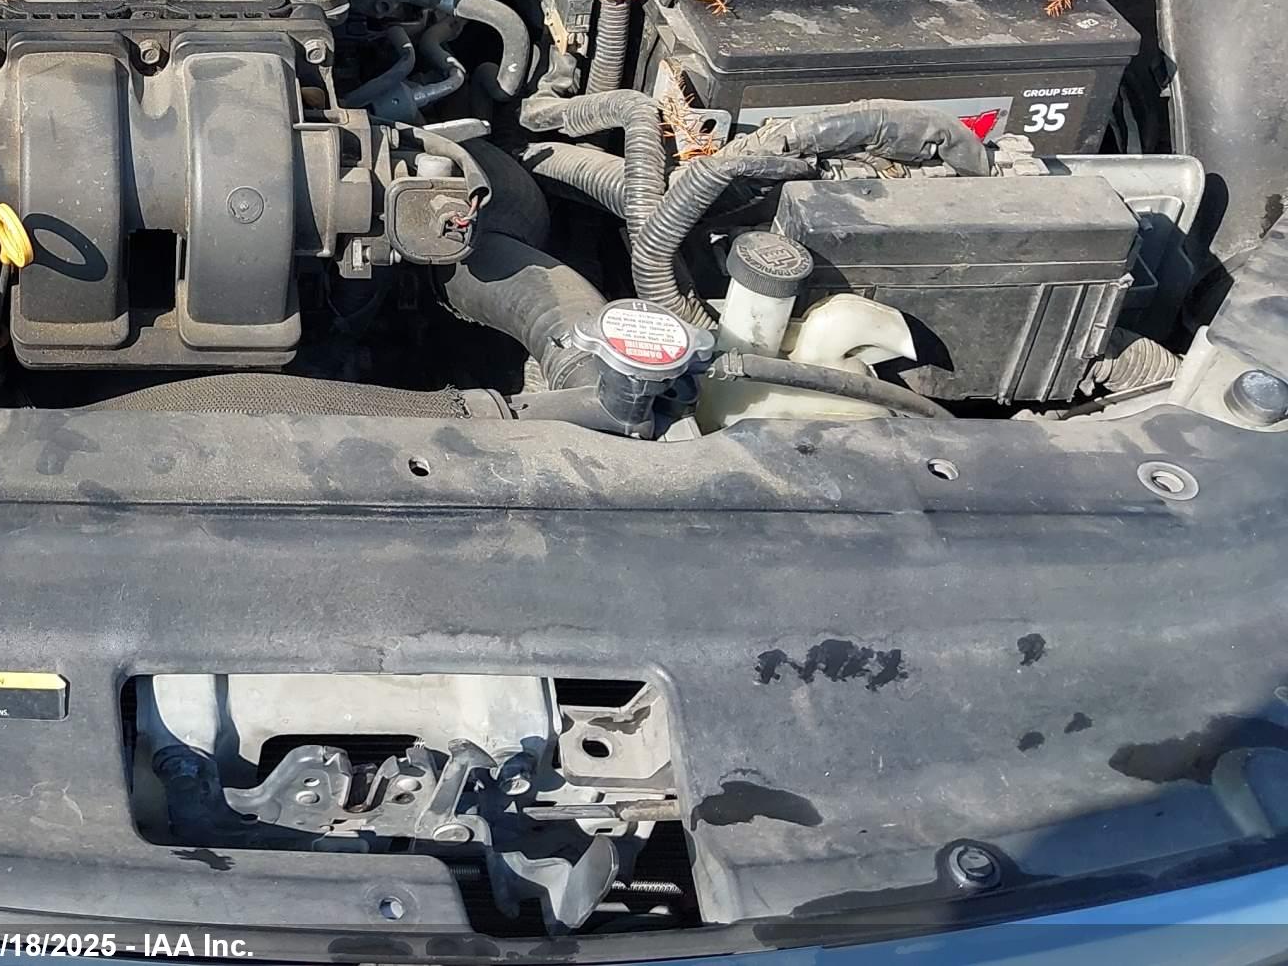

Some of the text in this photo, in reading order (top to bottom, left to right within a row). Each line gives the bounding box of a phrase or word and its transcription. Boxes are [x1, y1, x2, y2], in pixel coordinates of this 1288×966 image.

[1023, 86, 1085, 98] GROUP SIZE
[1024, 102, 1069, 133] 35
